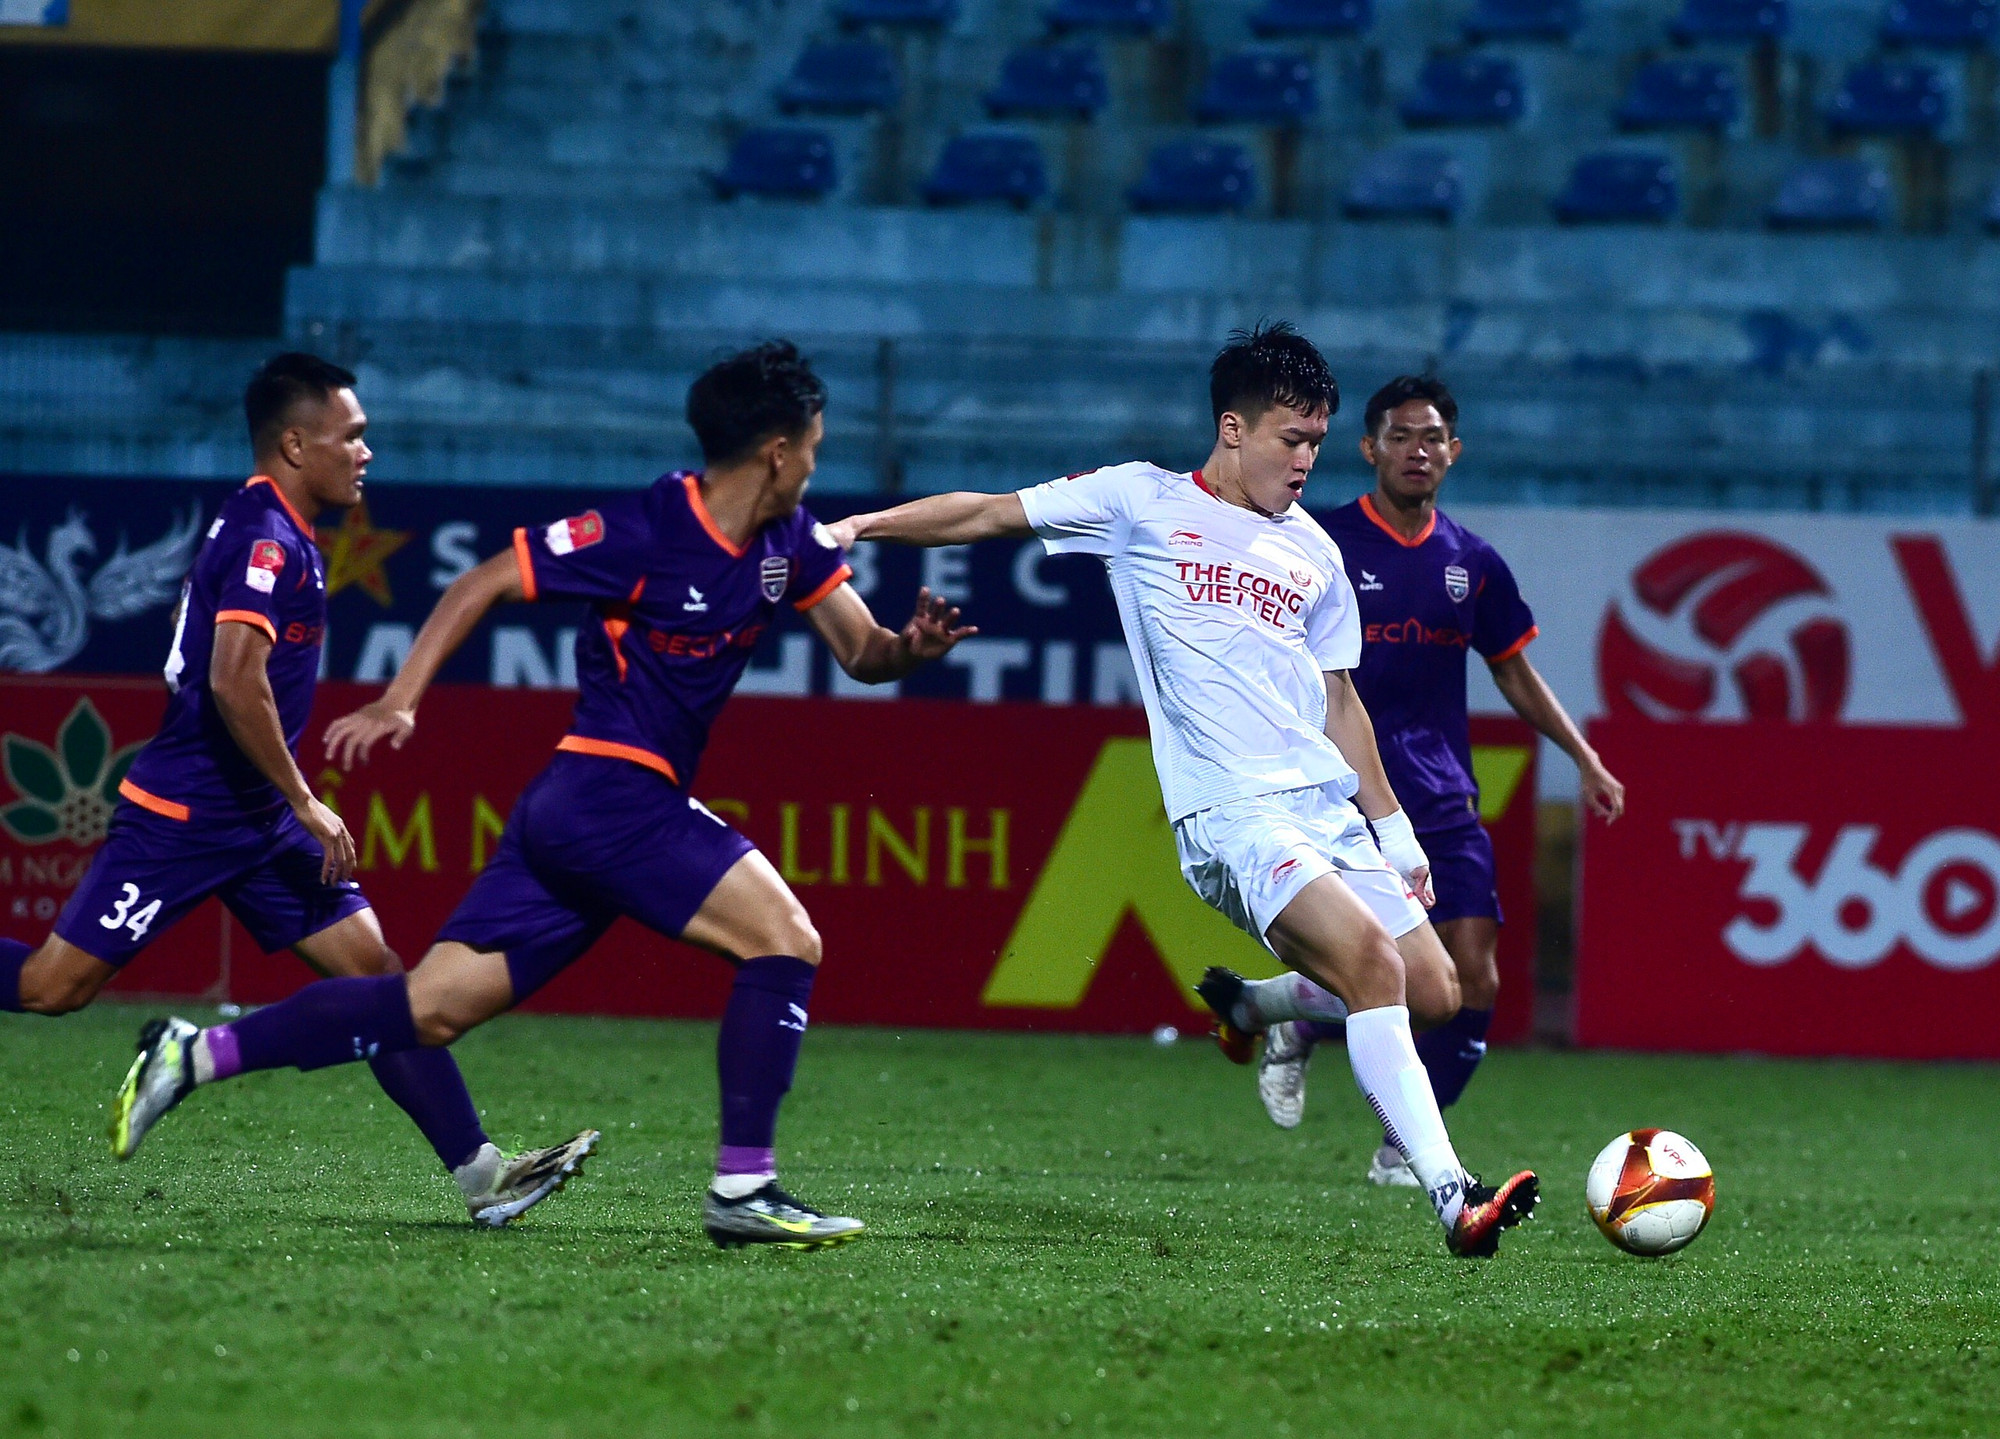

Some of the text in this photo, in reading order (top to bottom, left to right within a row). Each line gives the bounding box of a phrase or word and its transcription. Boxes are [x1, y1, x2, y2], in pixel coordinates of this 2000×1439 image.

[1185, 584, 1285, 629] VIETTEL
[1365, 616, 1472, 648] ECAMEX
[779, 801, 1011, 888] LINH
[99, 882, 163, 942] 34
[1663, 1144, 1687, 1167] VPF
